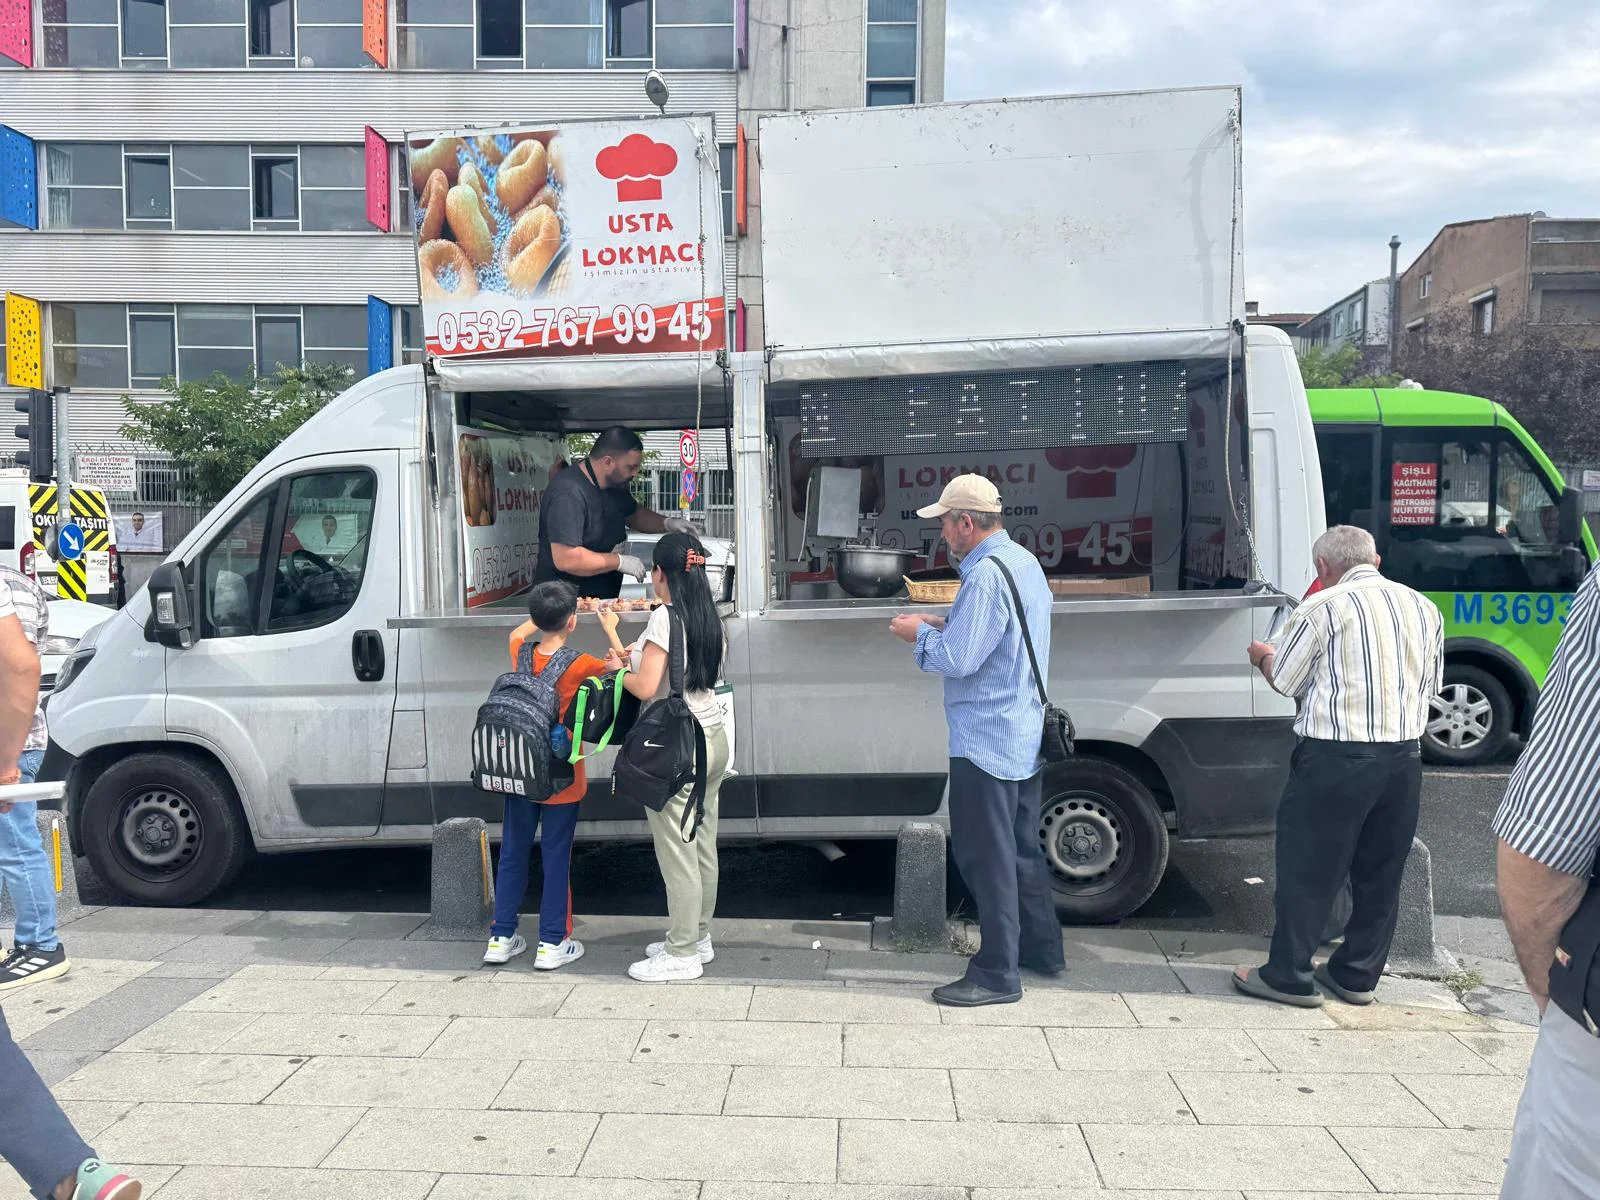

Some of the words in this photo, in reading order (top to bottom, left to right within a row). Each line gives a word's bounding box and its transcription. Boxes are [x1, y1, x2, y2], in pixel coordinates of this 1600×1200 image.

[608, 212, 674, 234] USTA
[582, 242, 702, 267] LOKMACI
[436, 309, 525, 352] 0532
[534, 306, 600, 348] 767
[612, 303, 656, 344] 99
[667, 301, 712, 342] 45
[682, 442, 694, 458] 30
[1401, 465, 1431, 477] ŞİŞLİ
[1394, 487, 1437, 497] ÇAĞLAYAN
[1393, 506, 1436, 514] NURTEPE
[74, 516, 106, 531] TAŞITI
[1078, 519, 1132, 567] 45
